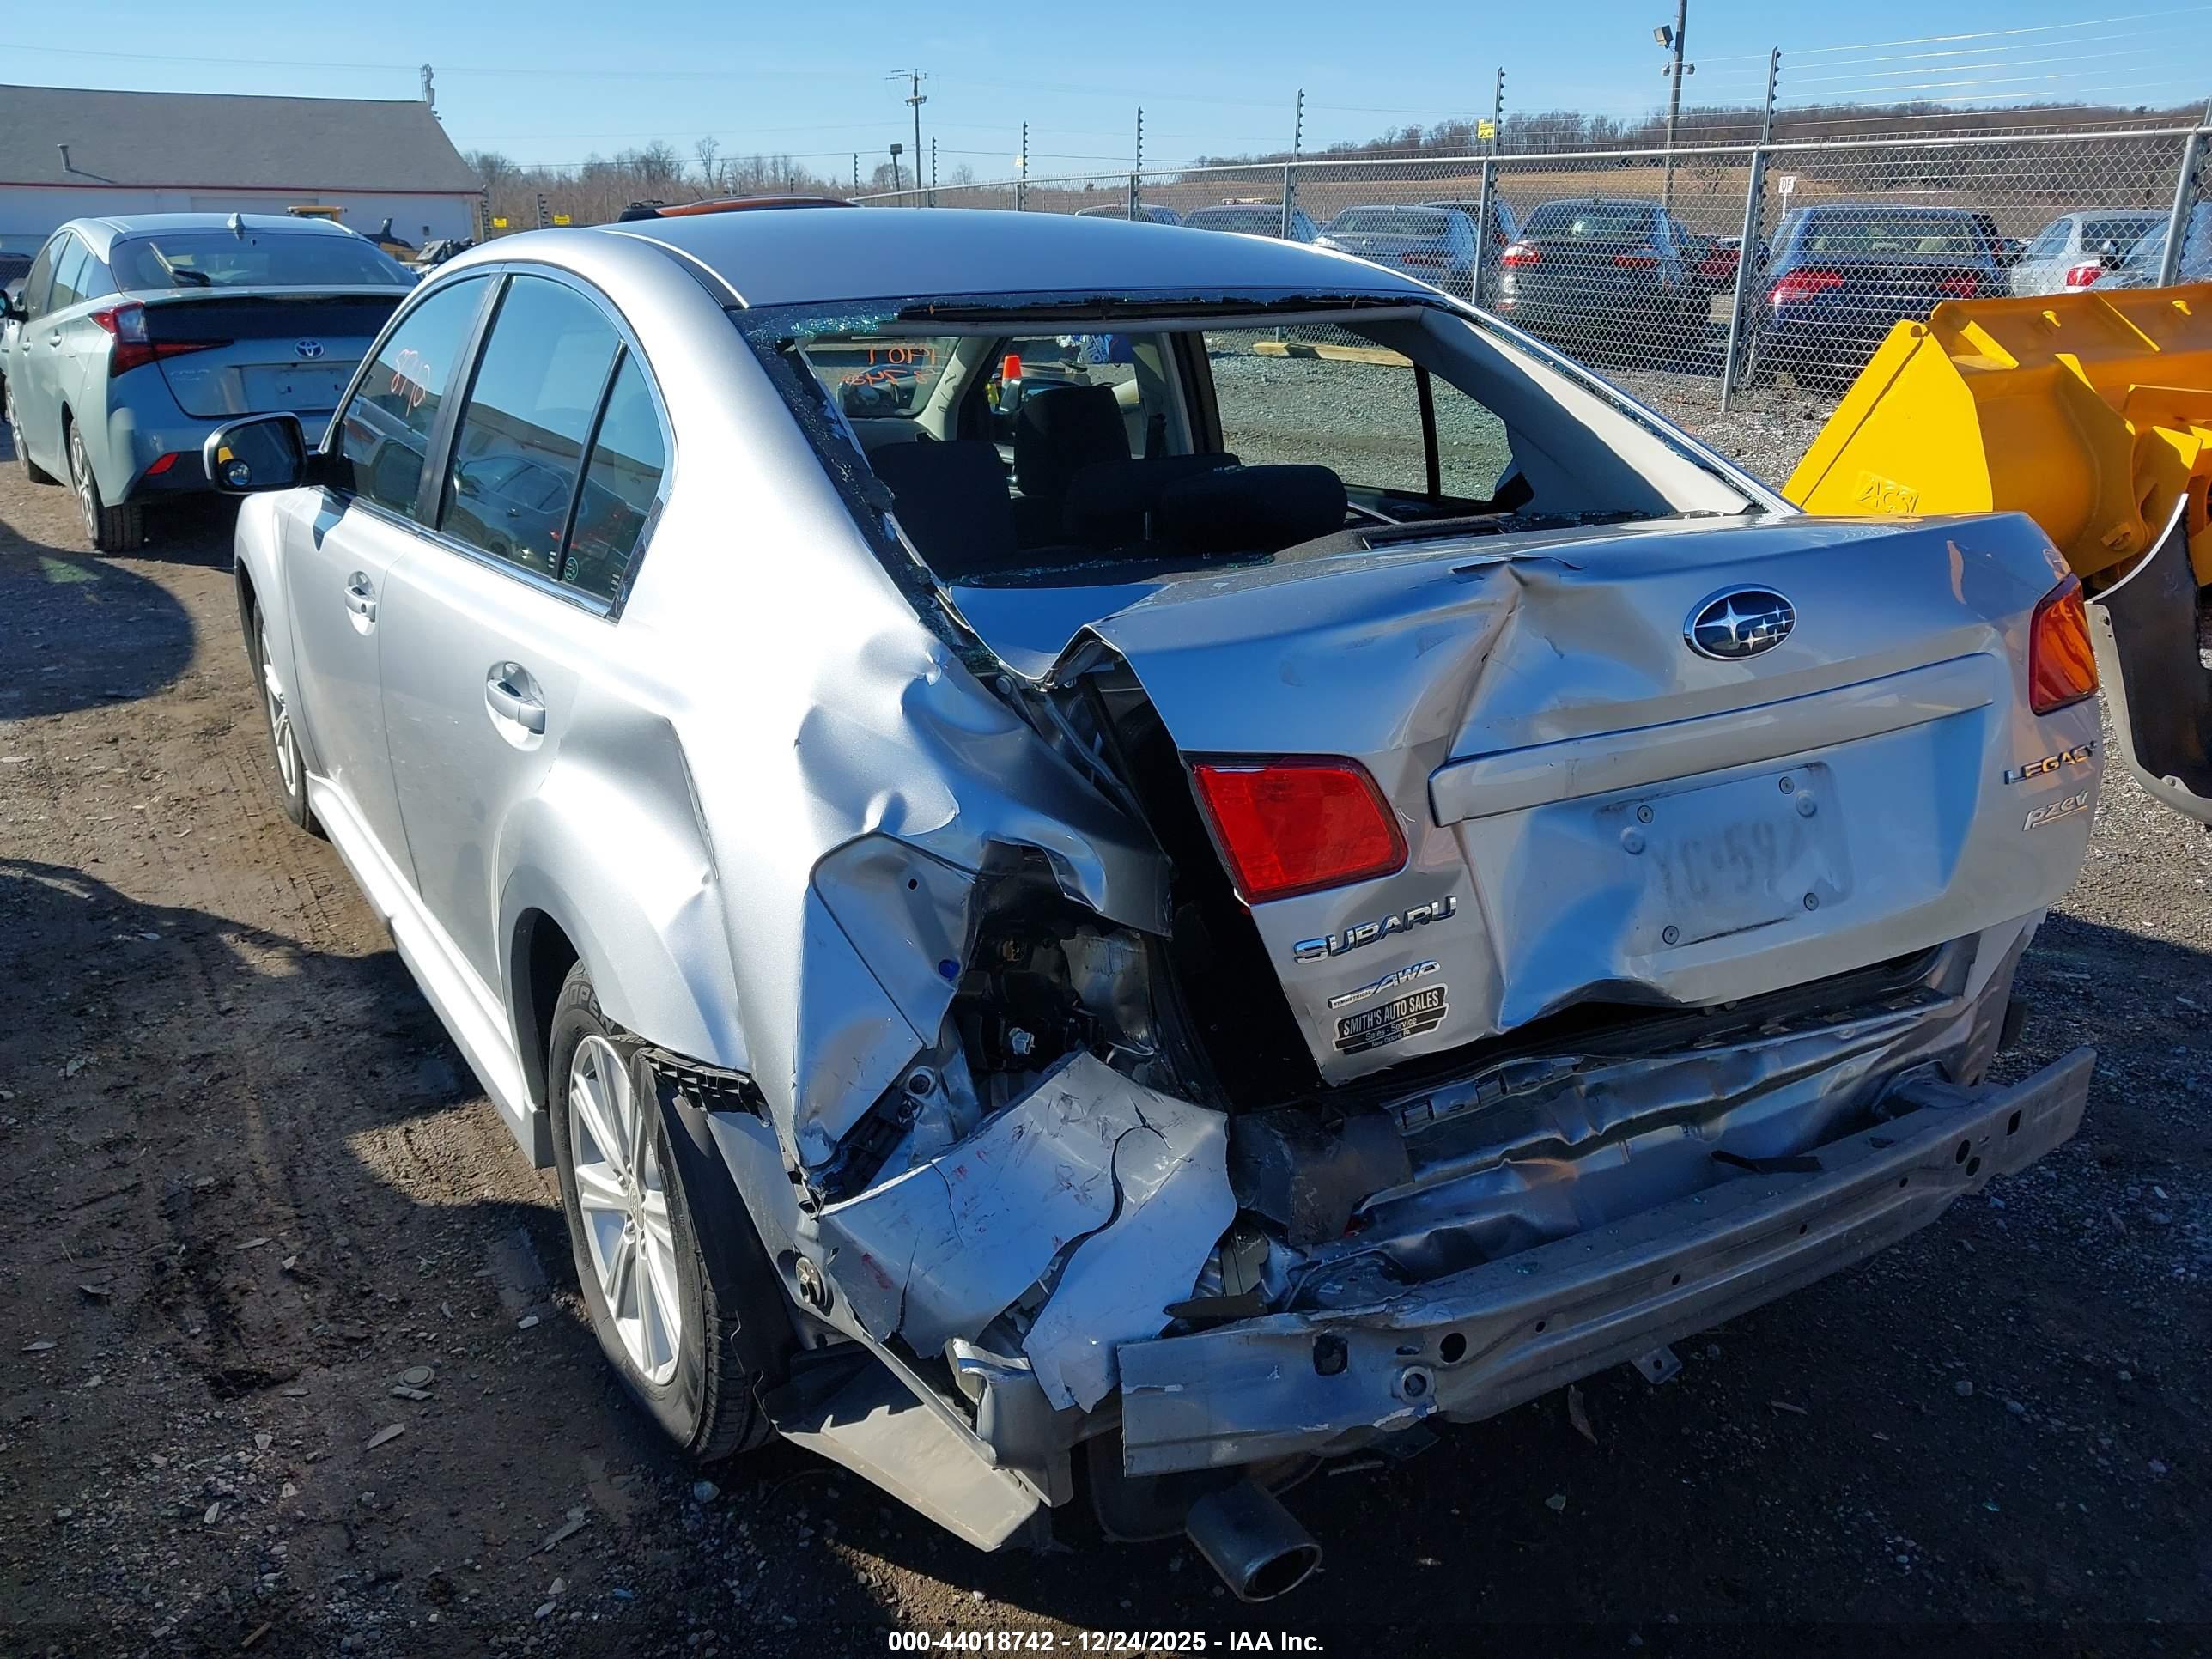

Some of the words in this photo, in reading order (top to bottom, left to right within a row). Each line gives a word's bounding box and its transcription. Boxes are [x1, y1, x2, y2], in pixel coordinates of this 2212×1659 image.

[2003, 739, 2098, 785] LEGACY
[1293, 895, 1457, 964] SUBARU
[1334, 989, 1371, 1006] SYMMETRICAL
[1375, 960, 1441, 995] AWD
[1343, 1009, 1382, 1036] SMITH'S
[1384, 1000, 1408, 1025] AUTO
[1409, 990, 1439, 1012] SALES
[1365, 1029, 1386, 1042] Sales
[1391, 1018, 1418, 1030] Service
